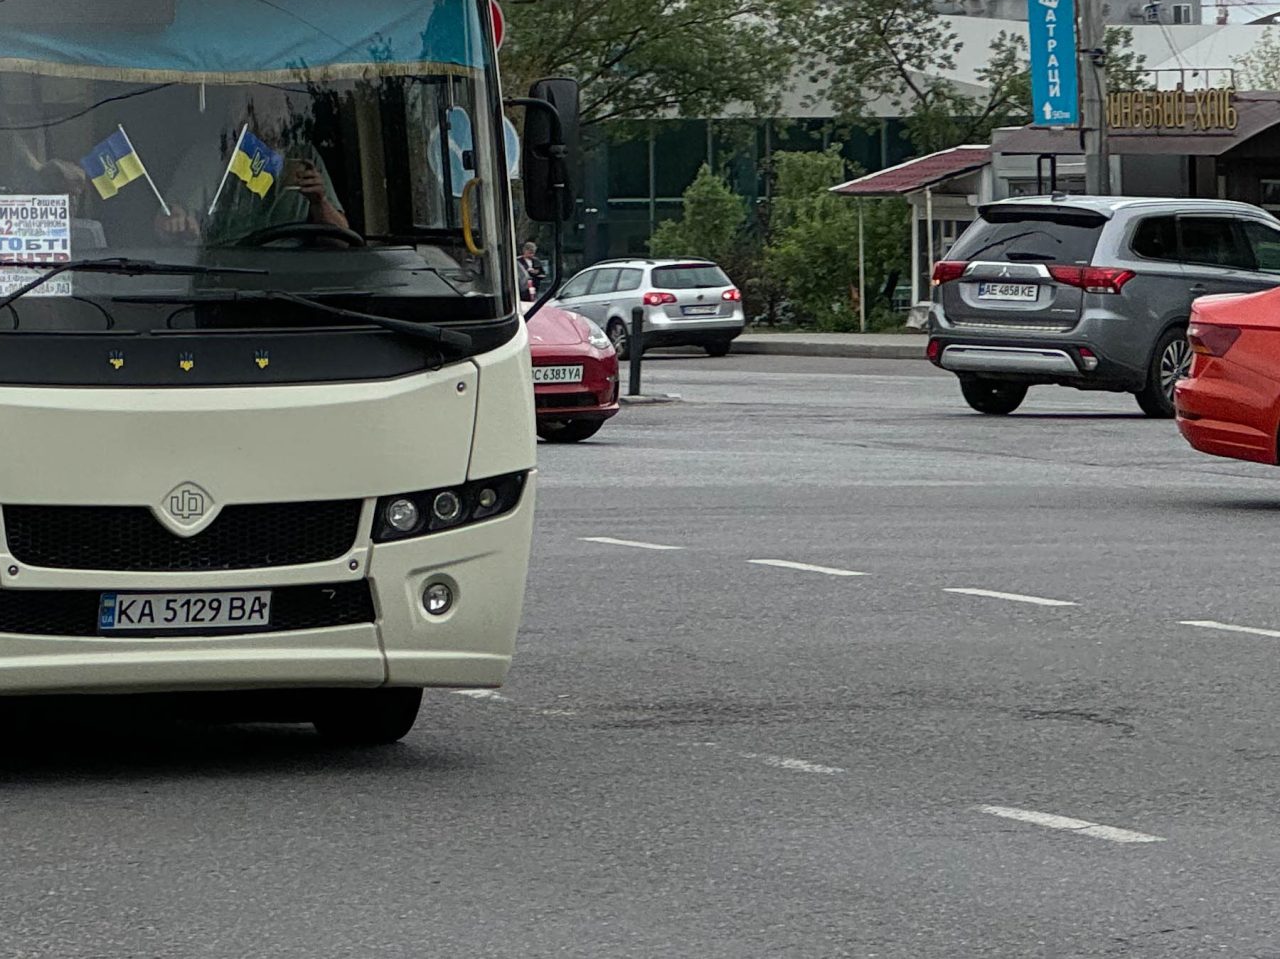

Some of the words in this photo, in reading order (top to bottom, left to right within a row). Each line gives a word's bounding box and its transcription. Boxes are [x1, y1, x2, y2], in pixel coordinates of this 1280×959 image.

[25, 238, 68, 251] БТІ
[985, 284, 997, 296] AE
[999, 285, 1020, 296] 4858
[1021, 286, 1034, 297] KE
[532, 369, 541, 381] C
[543, 368, 567, 380] 6383
[568, 368, 581, 379] YA
[117, 599, 155, 624] KA
[163, 598, 222, 623] 5129
[228, 596, 265, 621] BA
[101, 615, 114, 624] UA
